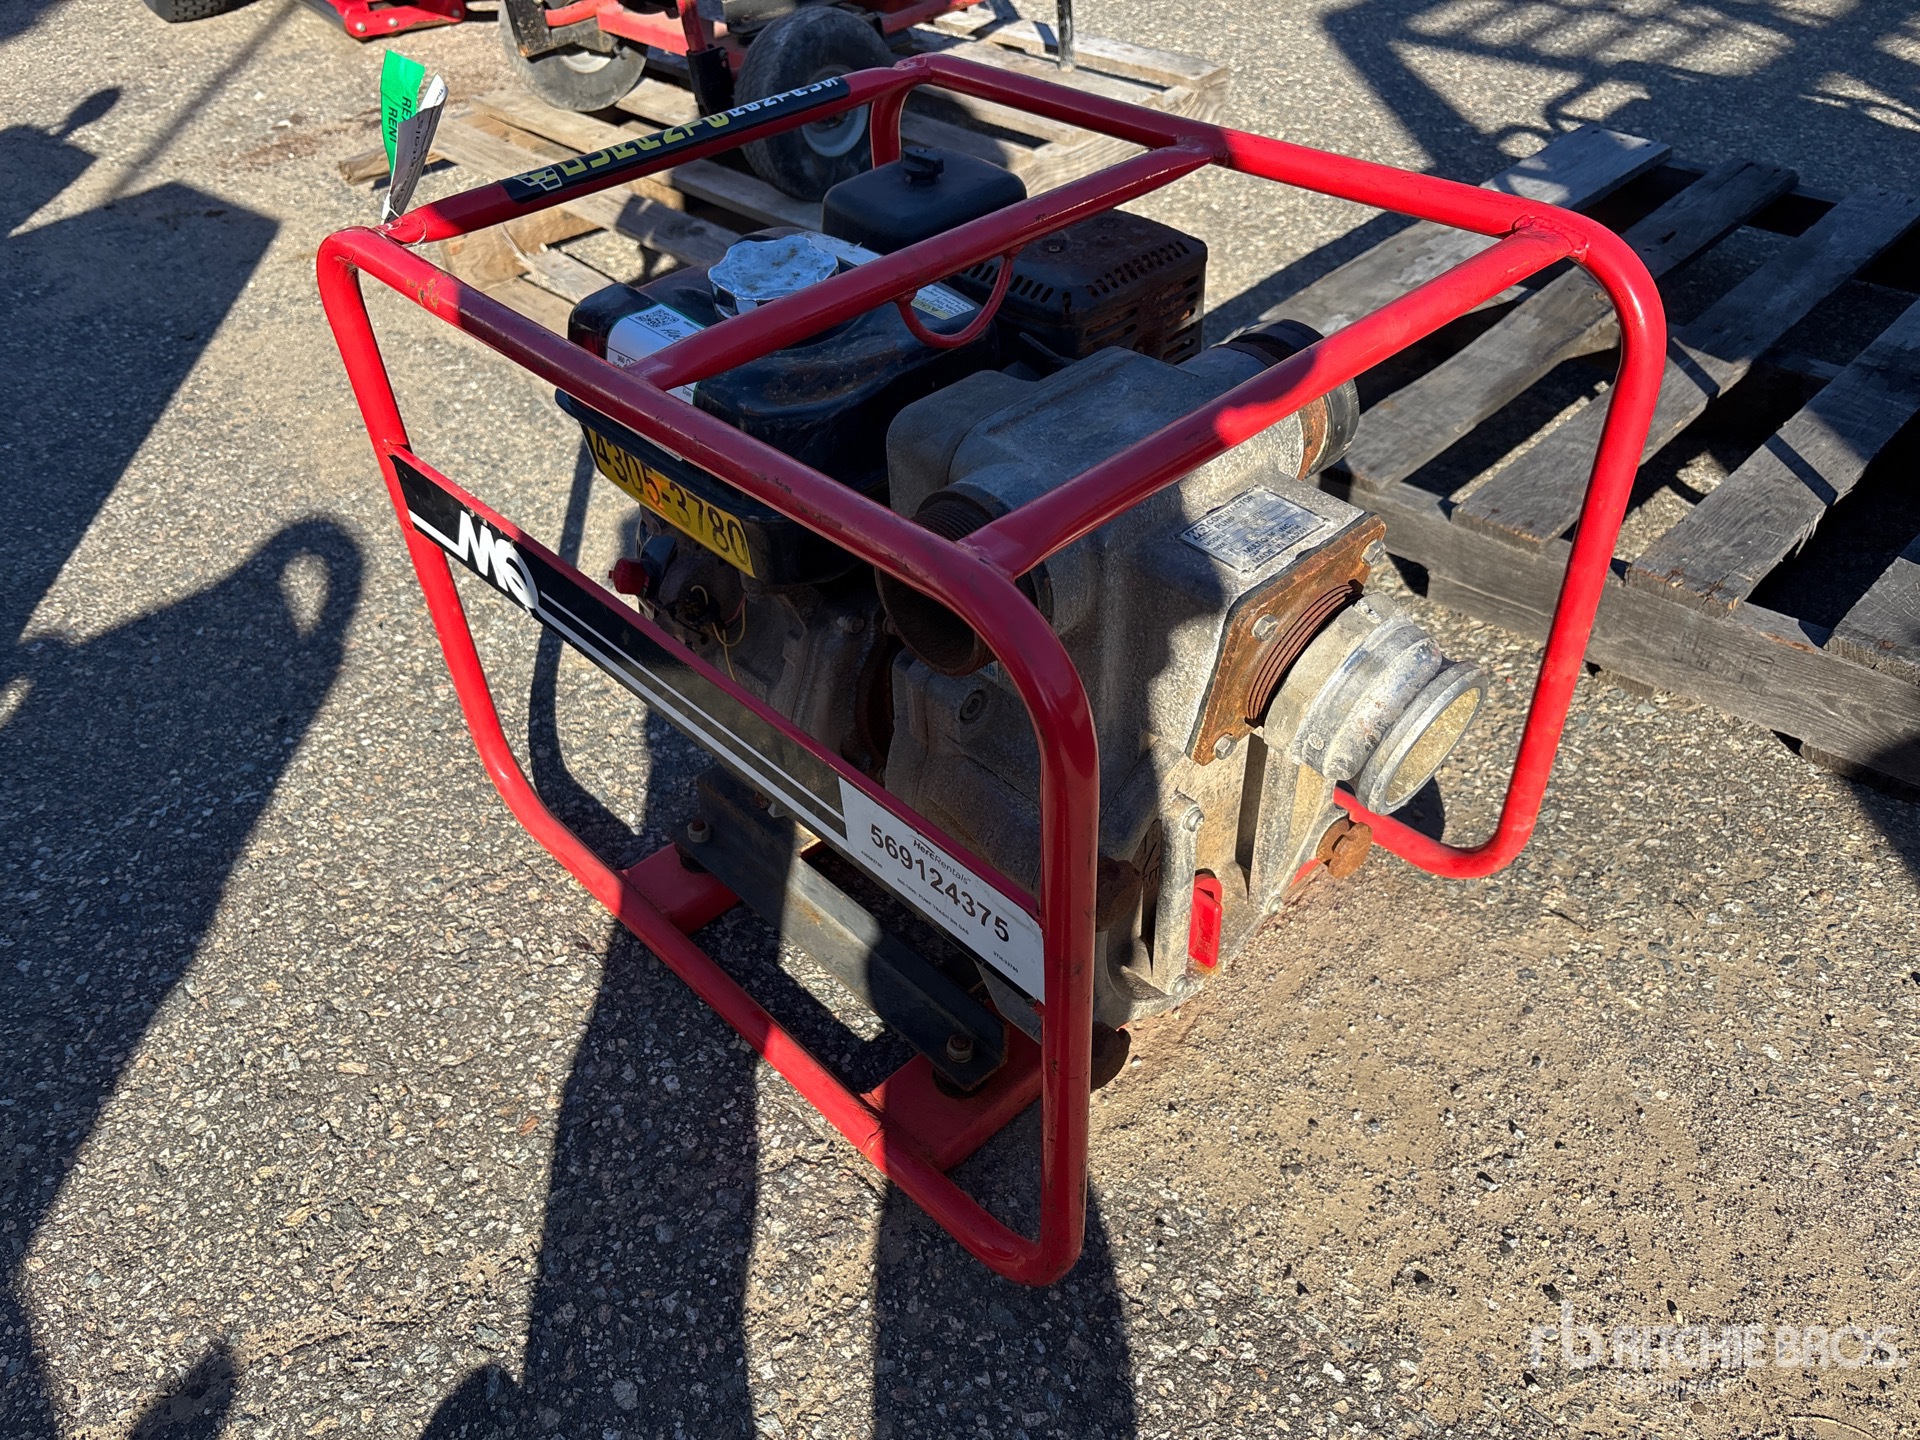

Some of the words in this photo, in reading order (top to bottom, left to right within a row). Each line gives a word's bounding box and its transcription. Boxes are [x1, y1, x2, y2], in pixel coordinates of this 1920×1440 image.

[1206, 495, 1256, 525] CONTRACTOR
[1214, 515, 1236, 530] PUMP
[1251, 548, 1277, 564] MADE
[870, 823, 1010, 943] 569124375
